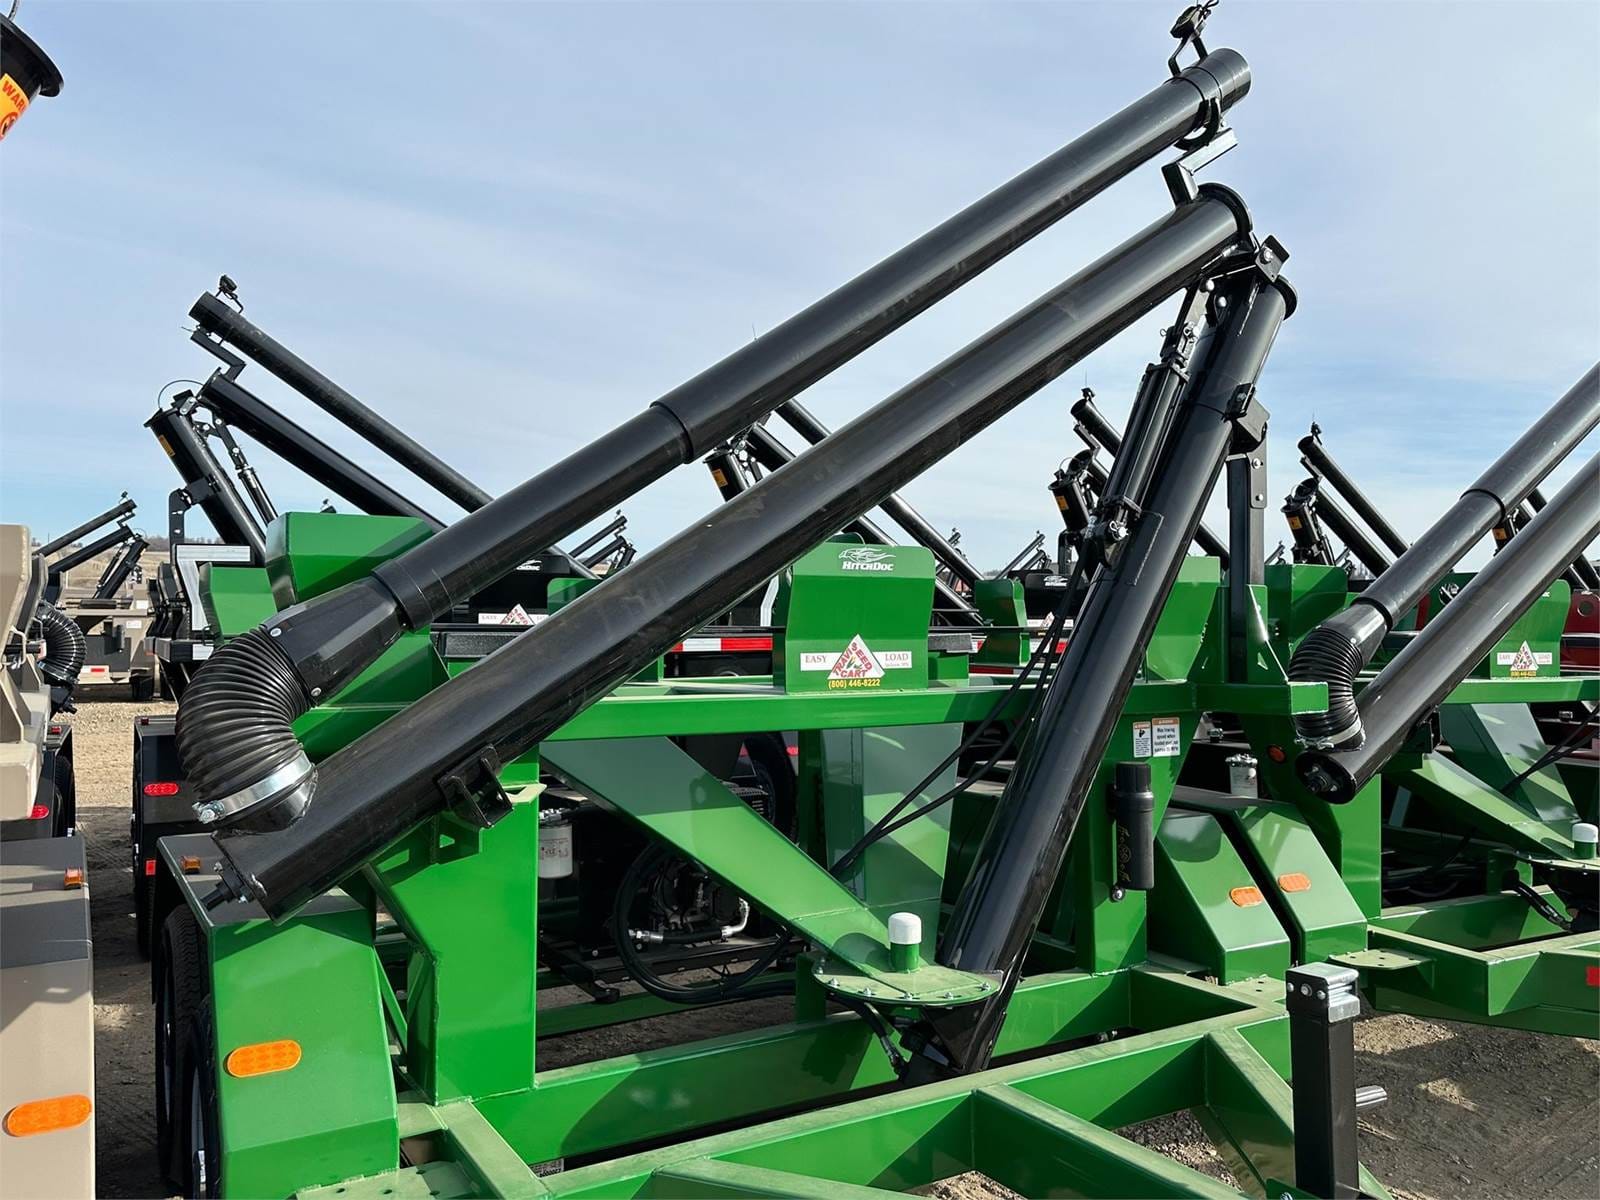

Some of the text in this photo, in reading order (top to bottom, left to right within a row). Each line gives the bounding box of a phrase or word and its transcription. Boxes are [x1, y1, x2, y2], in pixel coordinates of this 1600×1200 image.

[805, 655, 828, 664] EASY
[885, 653, 909, 661] LOAD
[840, 669, 868, 678] CART
